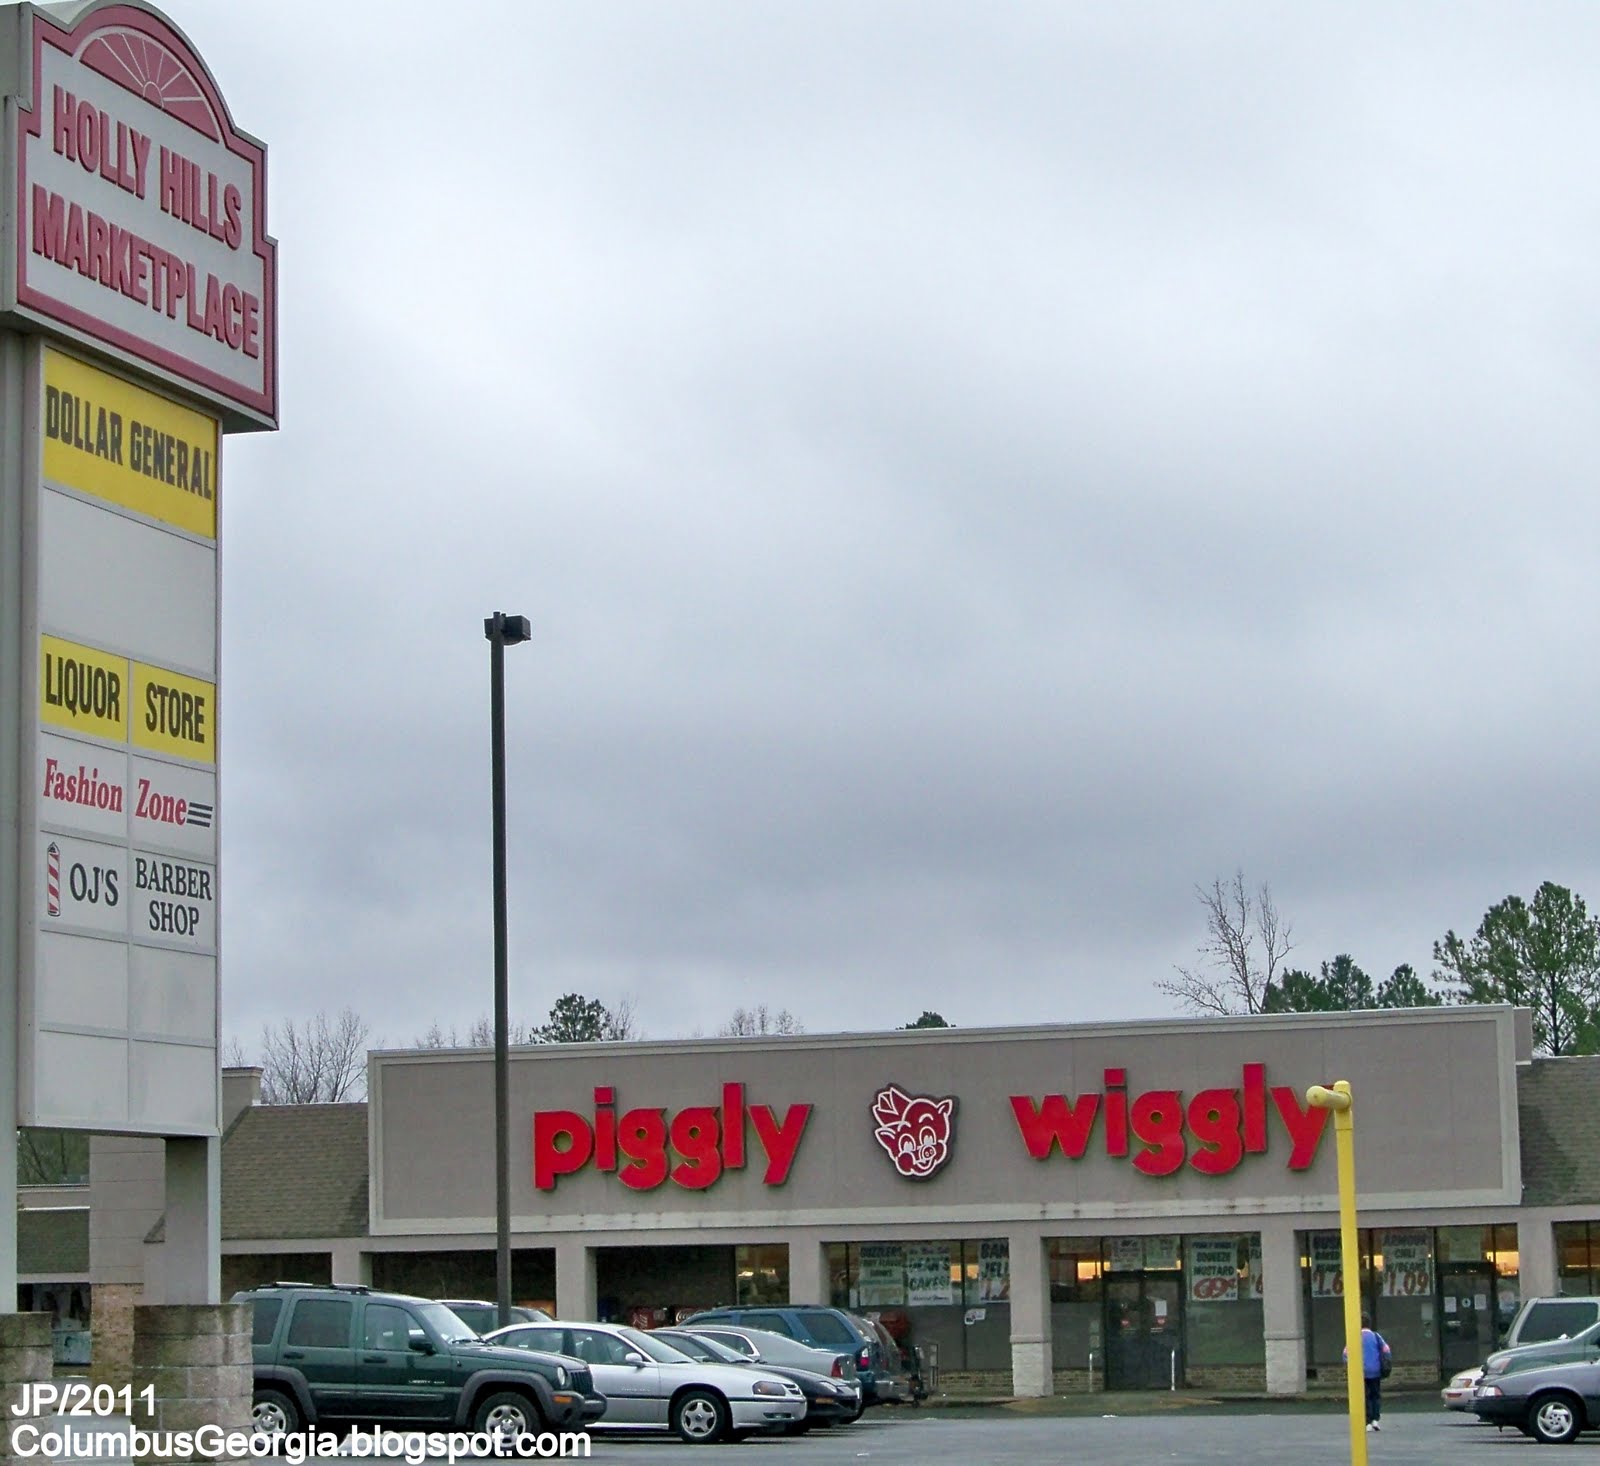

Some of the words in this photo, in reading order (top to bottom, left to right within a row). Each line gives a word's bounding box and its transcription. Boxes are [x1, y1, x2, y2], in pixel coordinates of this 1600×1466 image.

[53, 84, 151, 200] HOLLY
[160, 145, 242, 251] HILLS
[32, 182, 259, 360] MARKETPLACE
[46, 384, 123, 466] DOLLAR
[130, 420, 212, 500] GENERAL
[45, 653, 121, 723] LIQUOR
[145, 682, 205, 744] STORE
[43, 758, 122, 813] Fashion
[135, 778, 187, 826] Zone
[70, 862, 119, 907] OJ'S
[135, 857, 212, 901] BARBER
[149, 900, 199, 937] SHOP
[533, 1082, 812, 1191] piggly
[1009, 1062, 1334, 1176] wiggly
